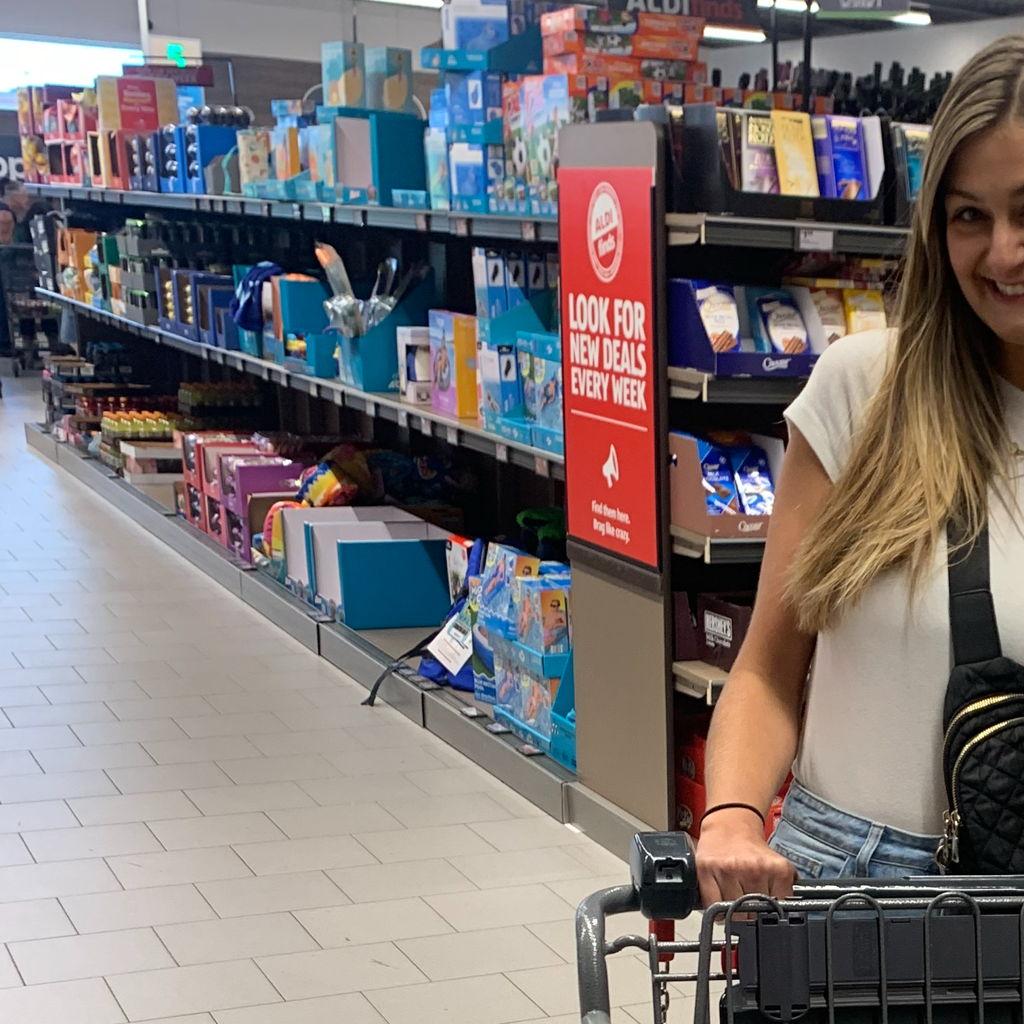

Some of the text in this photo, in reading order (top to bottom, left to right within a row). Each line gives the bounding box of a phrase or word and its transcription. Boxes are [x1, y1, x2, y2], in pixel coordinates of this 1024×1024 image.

[626, 0, 691, 15] ALDI
[569, 293, 646, 341] LOOK FOR
[570, 331, 647, 378] NEW DEALS
[571, 366, 647, 411] EVERY WEEK
